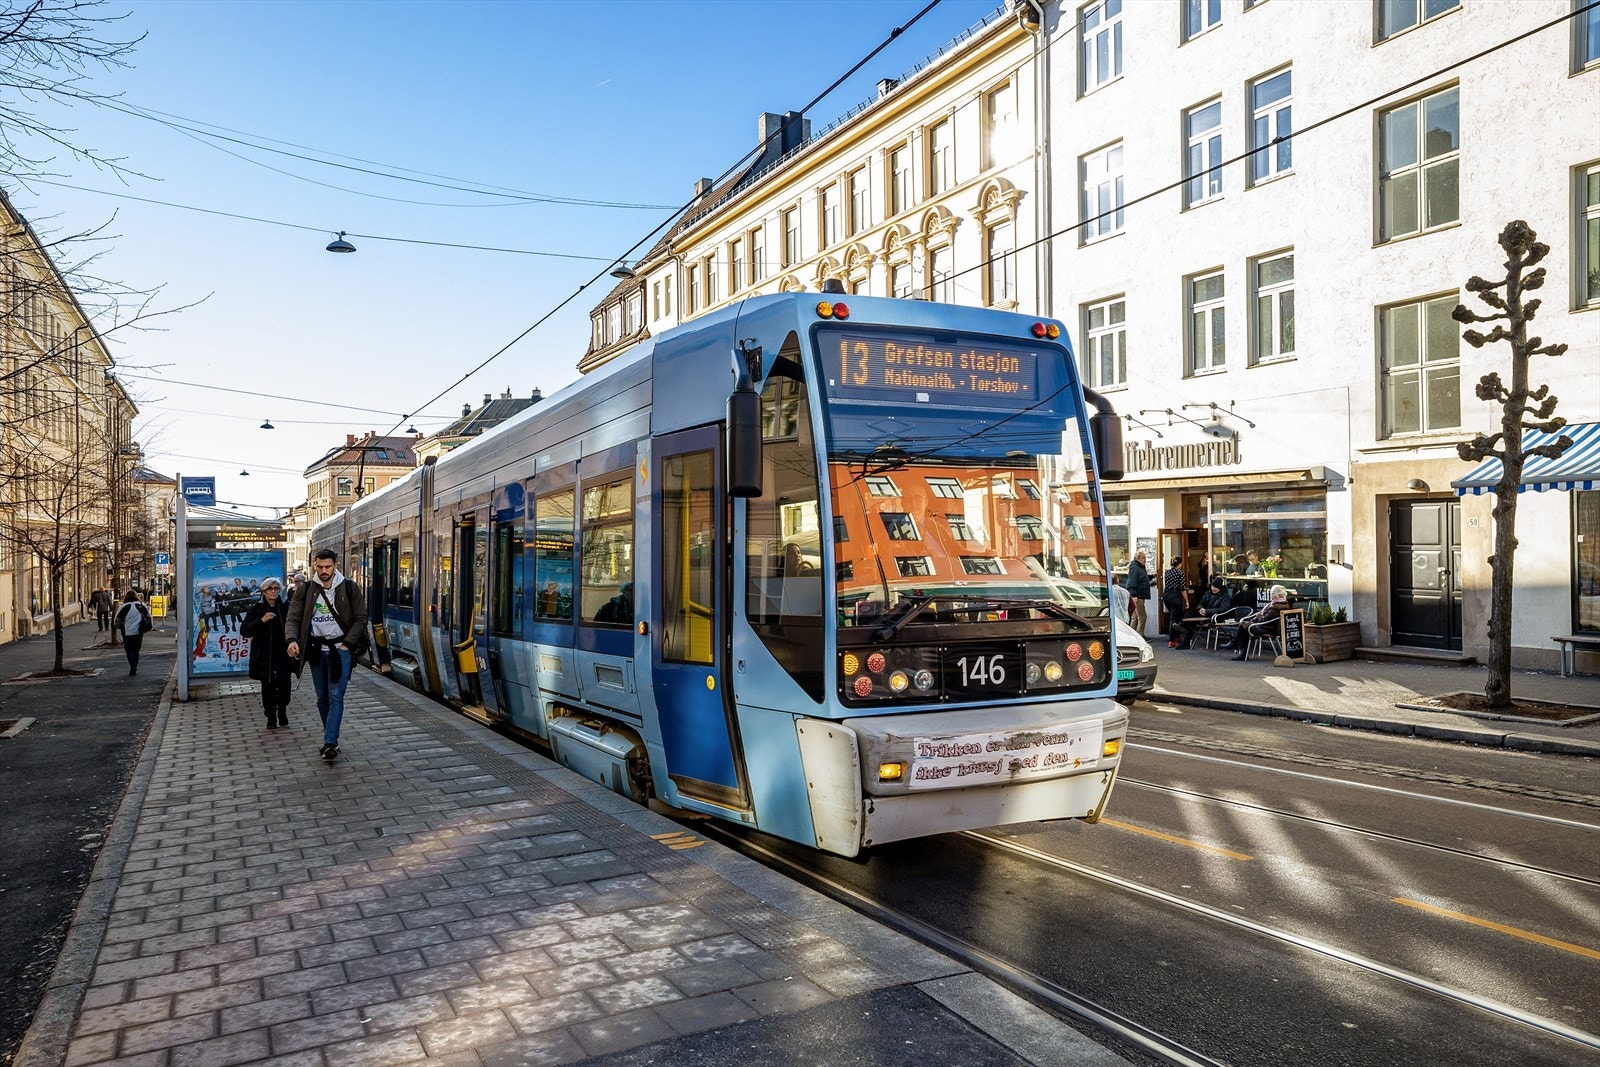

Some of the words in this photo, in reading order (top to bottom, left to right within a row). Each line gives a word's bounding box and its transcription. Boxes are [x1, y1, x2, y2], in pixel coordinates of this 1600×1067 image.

[841, 341, 869, 385] 13
[885, 342, 953, 368] Grefsen
[960, 350, 1019, 374] stasjon
[969, 375, 1019, 393] Torshov
[1122, 430, 1242, 473] ffebrenneriet
[312, 615, 335, 623] adida
[227, 648, 249, 663] fje
[957, 654, 1006, 687] 146
[918, 742, 982, 758] Trikken
[915, 765, 952, 780] ikke
[957, 758, 1003, 777] kræsj
[1044, 752, 1069, 767] den
